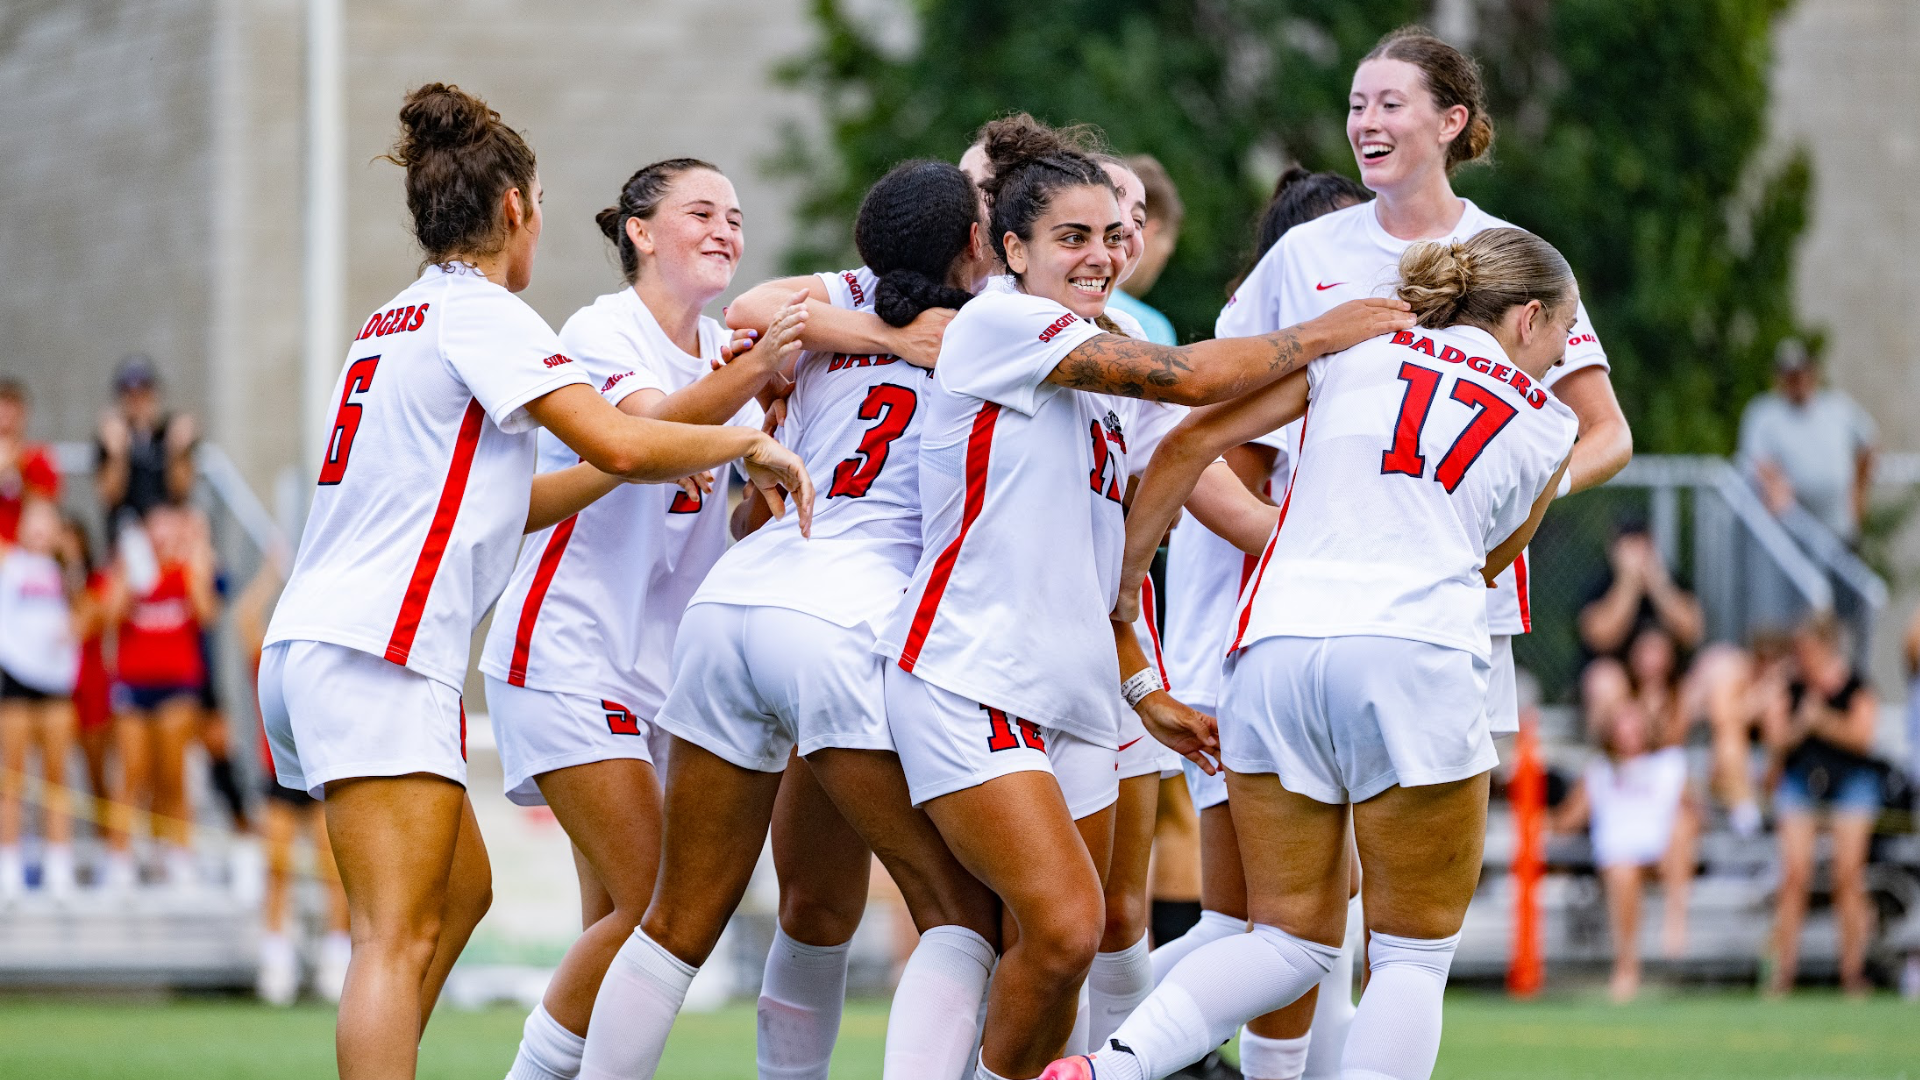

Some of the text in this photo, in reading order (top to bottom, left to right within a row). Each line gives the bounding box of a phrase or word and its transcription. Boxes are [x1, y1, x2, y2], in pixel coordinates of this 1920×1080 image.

[317, 354, 382, 486] 6
[1380, 360, 1519, 495] 17
[1390, 330, 1548, 410] BADGERS
[826, 382, 918, 499] 3
